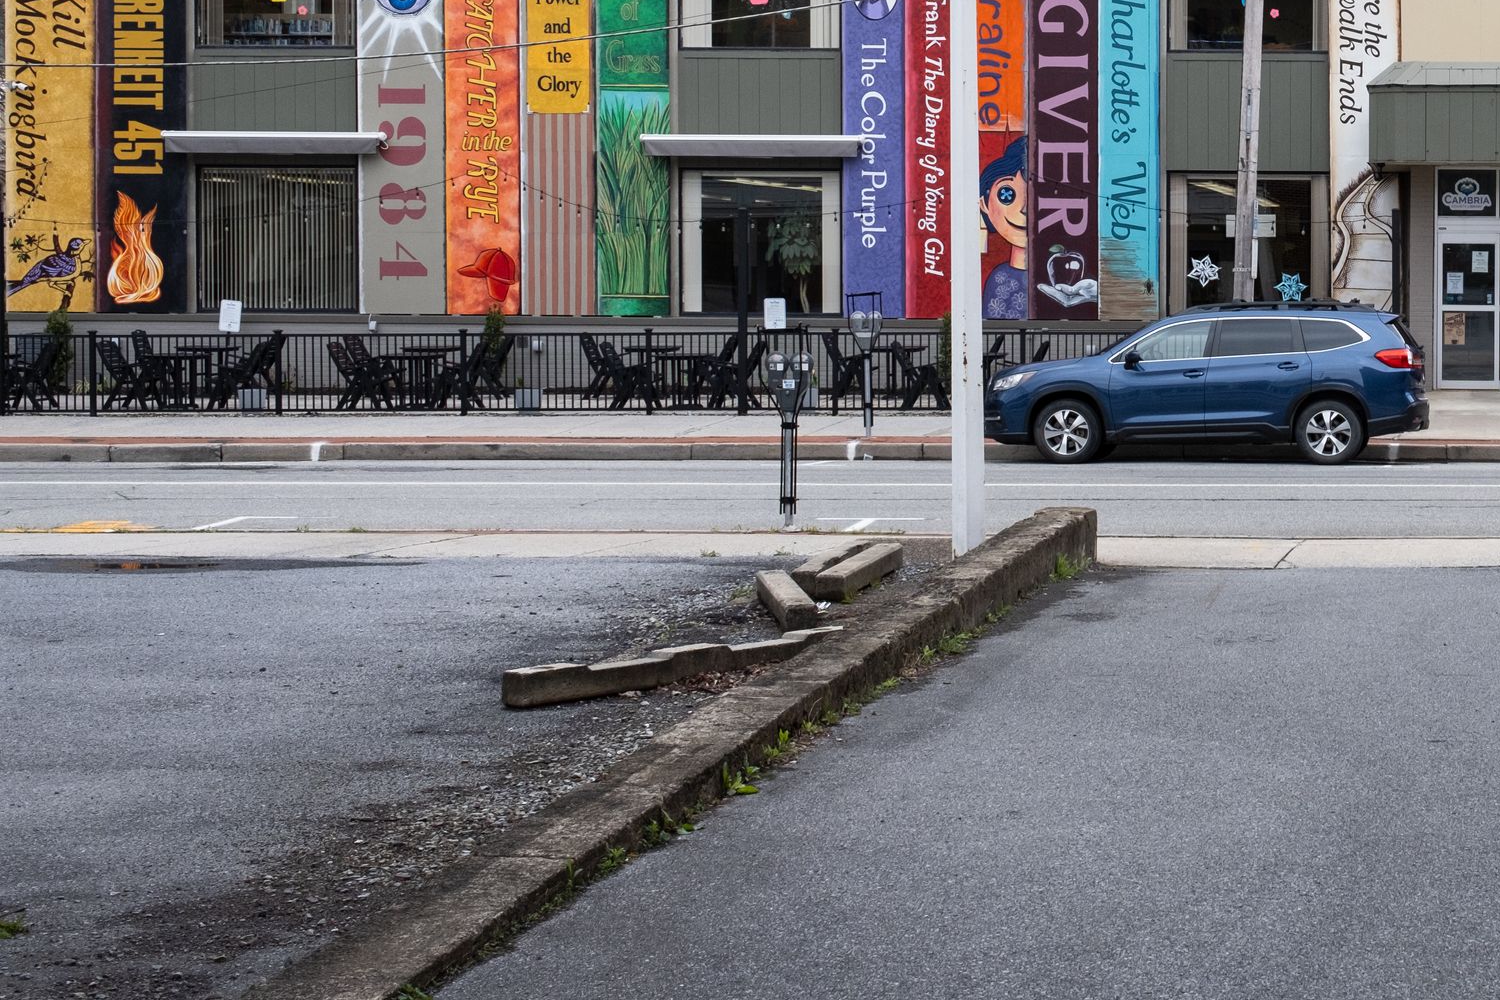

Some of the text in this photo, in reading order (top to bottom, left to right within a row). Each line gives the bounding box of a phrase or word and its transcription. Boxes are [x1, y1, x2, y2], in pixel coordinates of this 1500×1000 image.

[543, 17, 571, 35] and
[1364, 21, 1388, 58] the
[547, 48, 572, 64] the
[605, 39, 661, 74] Grass
[537, 75, 582, 99] Glory
[924, 57, 945, 92] The
[1339, 59, 1363, 126] Ends
[916, 95, 944, 149] Diary
[113, 120, 165, 176] 451
[461, 130, 512, 152] in the
[852, 38, 888, 250] The Color Purple
[378, 83, 428, 281] 1984
[919, 154, 945, 177] of
[924, 173, 938, 184] a
[917, 186, 945, 234] Young
[1111, 161, 1147, 242] Web
[1445, 194, 1490, 204] CAMBRIA
[924, 238, 945, 277] Girl
